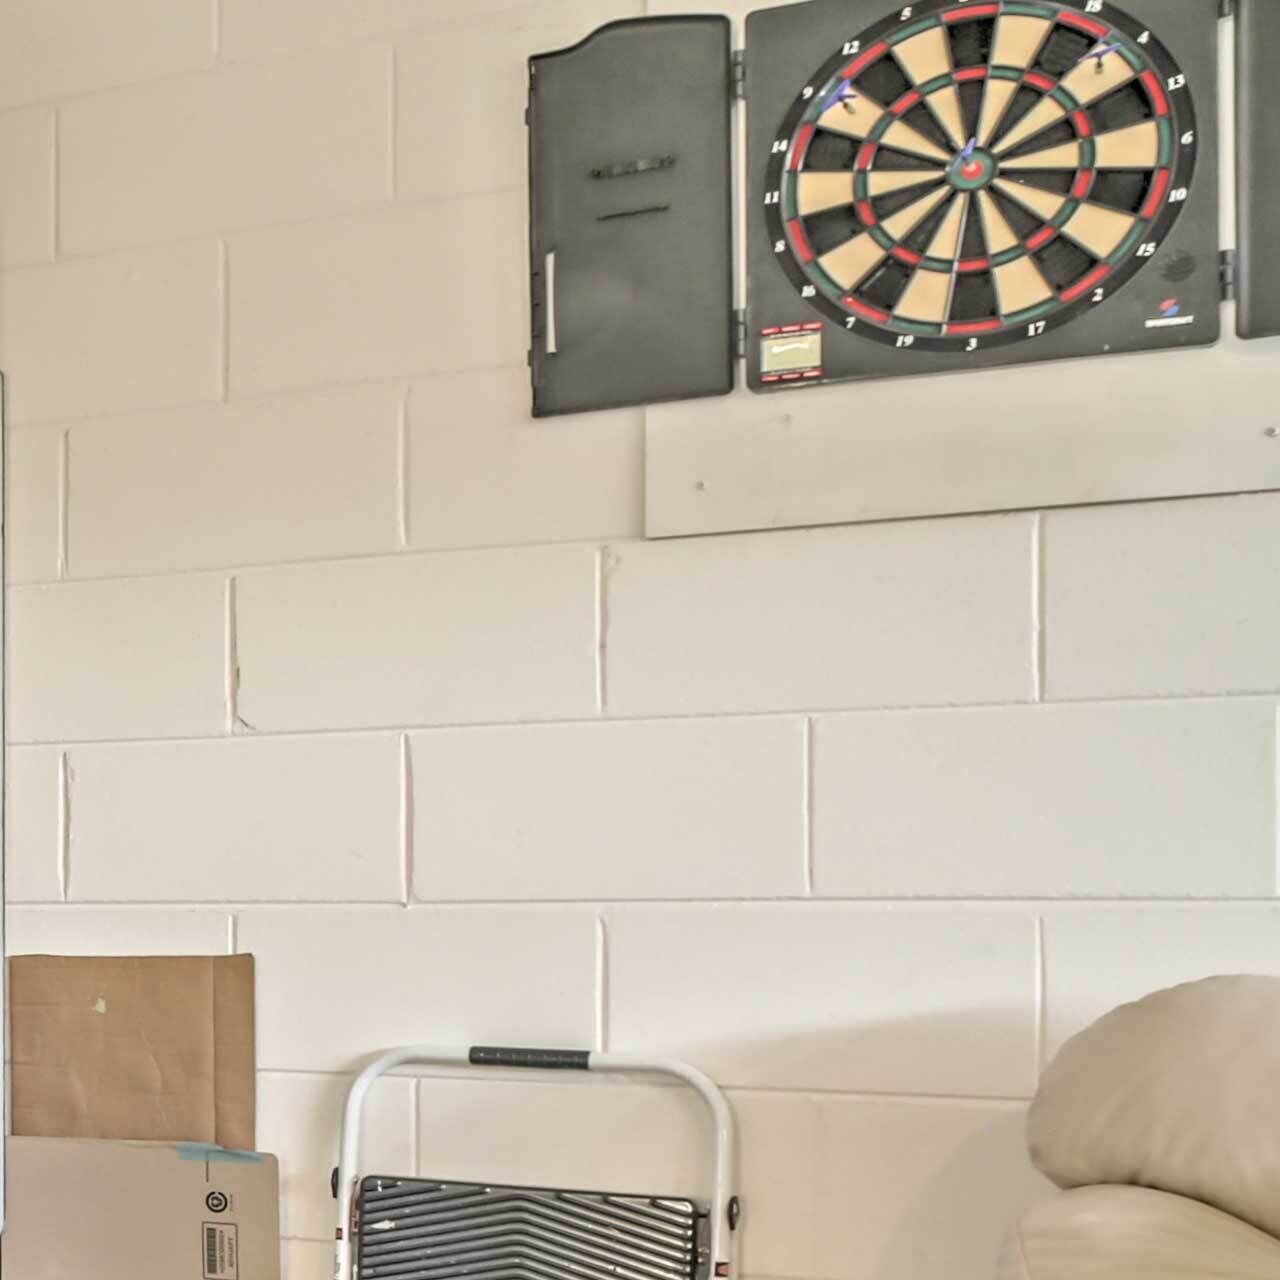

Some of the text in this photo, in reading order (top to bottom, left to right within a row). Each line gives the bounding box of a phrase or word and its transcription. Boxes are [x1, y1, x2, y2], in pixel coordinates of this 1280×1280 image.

[900, 7, 912, 21] 5
[1137, 31, 1150, 44] 4
[842, 41, 860, 55] 12
[1167, 74, 1185, 90] 13
[803, 86, 813, 99] 9
[1181, 131, 1193, 144] 6
[771, 140, 788, 153] 14
[764, 191, 780, 204] 11
[1168, 188, 1187, 202] 10
[774, 239, 786, 252] 8
[1136, 242, 1156, 257] 15
[801, 285, 816, 298] 16
[1091, 288, 1104, 302] 2
[845, 316, 855, 328] 7
[1027, 321, 1046, 336] 17
[896, 335, 914, 347] 19
[966, 337, 978, 351] 3
